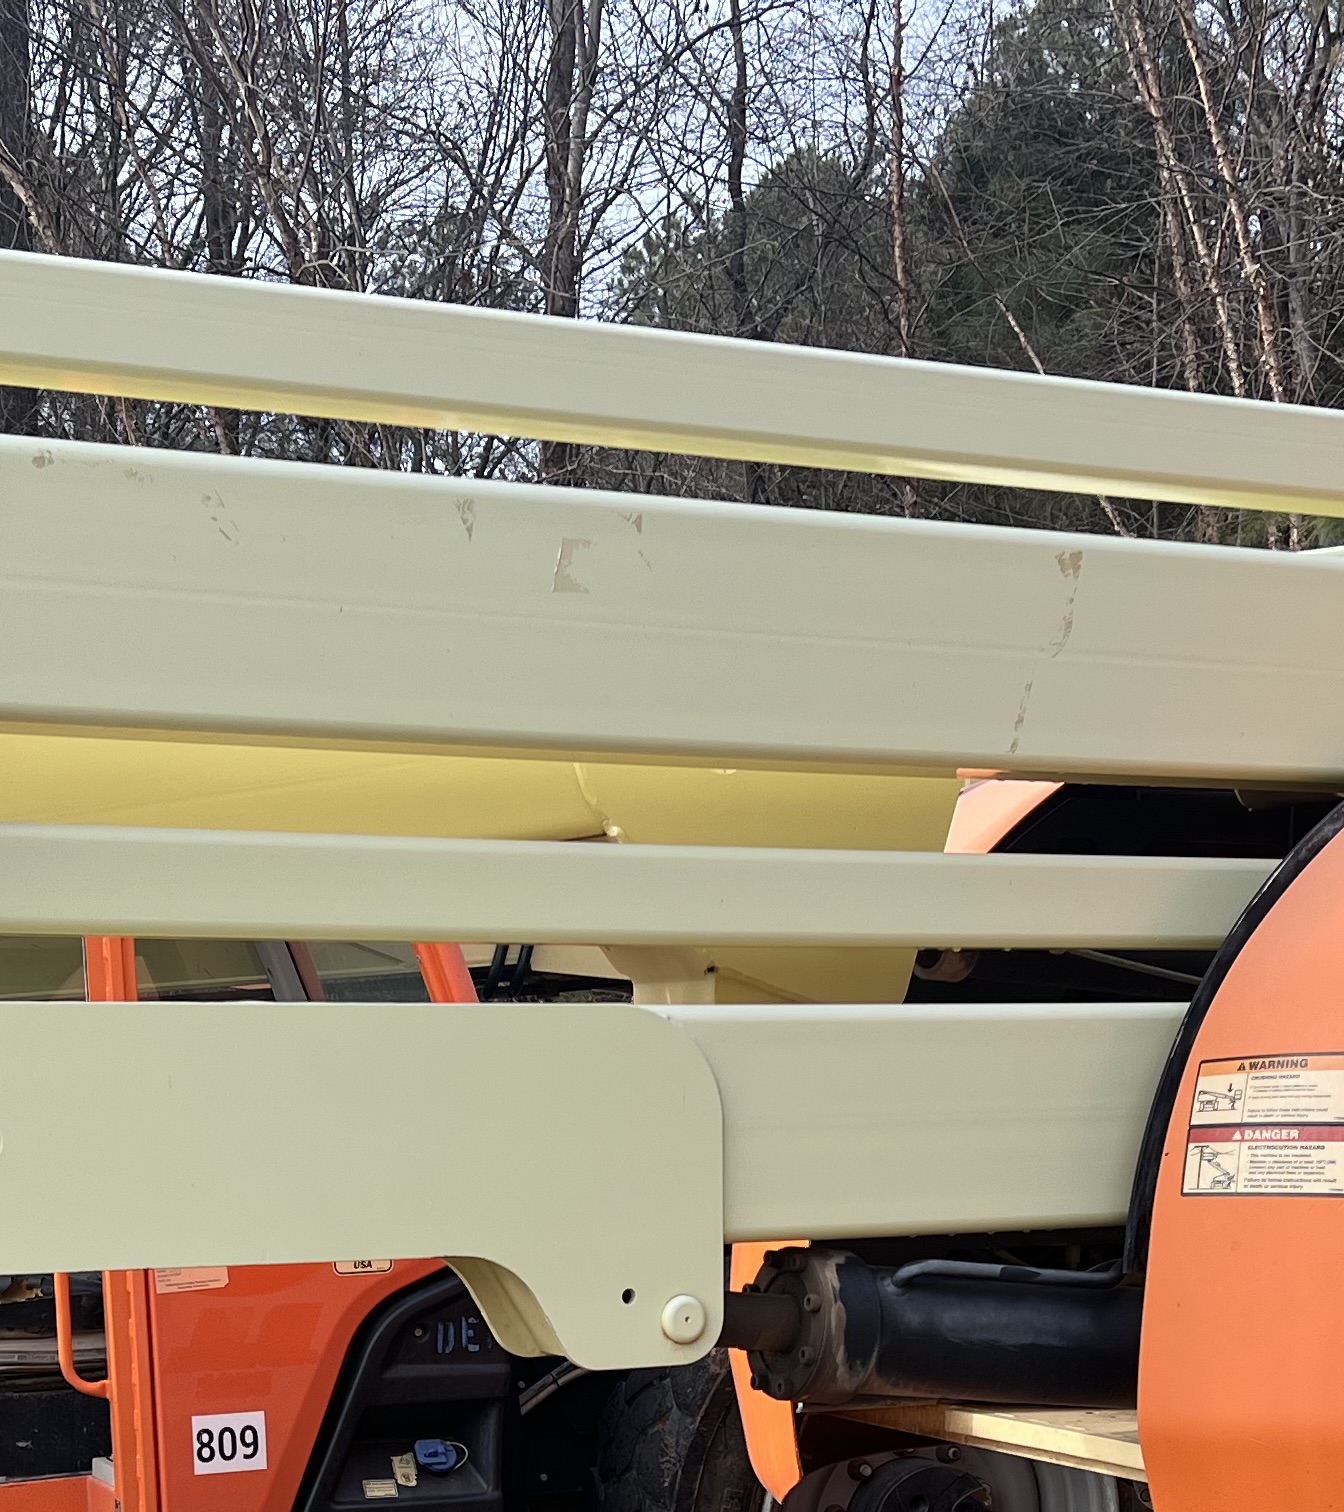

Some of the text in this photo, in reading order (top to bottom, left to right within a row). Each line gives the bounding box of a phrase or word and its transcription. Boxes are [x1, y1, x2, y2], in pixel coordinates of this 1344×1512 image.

[1249, 1058, 1309, 1071] WARNING
[1244, 1129, 1300, 1140] DANGER
[354, 1260, 373, 1270] USA
[196, 1425, 260, 1463] 809
